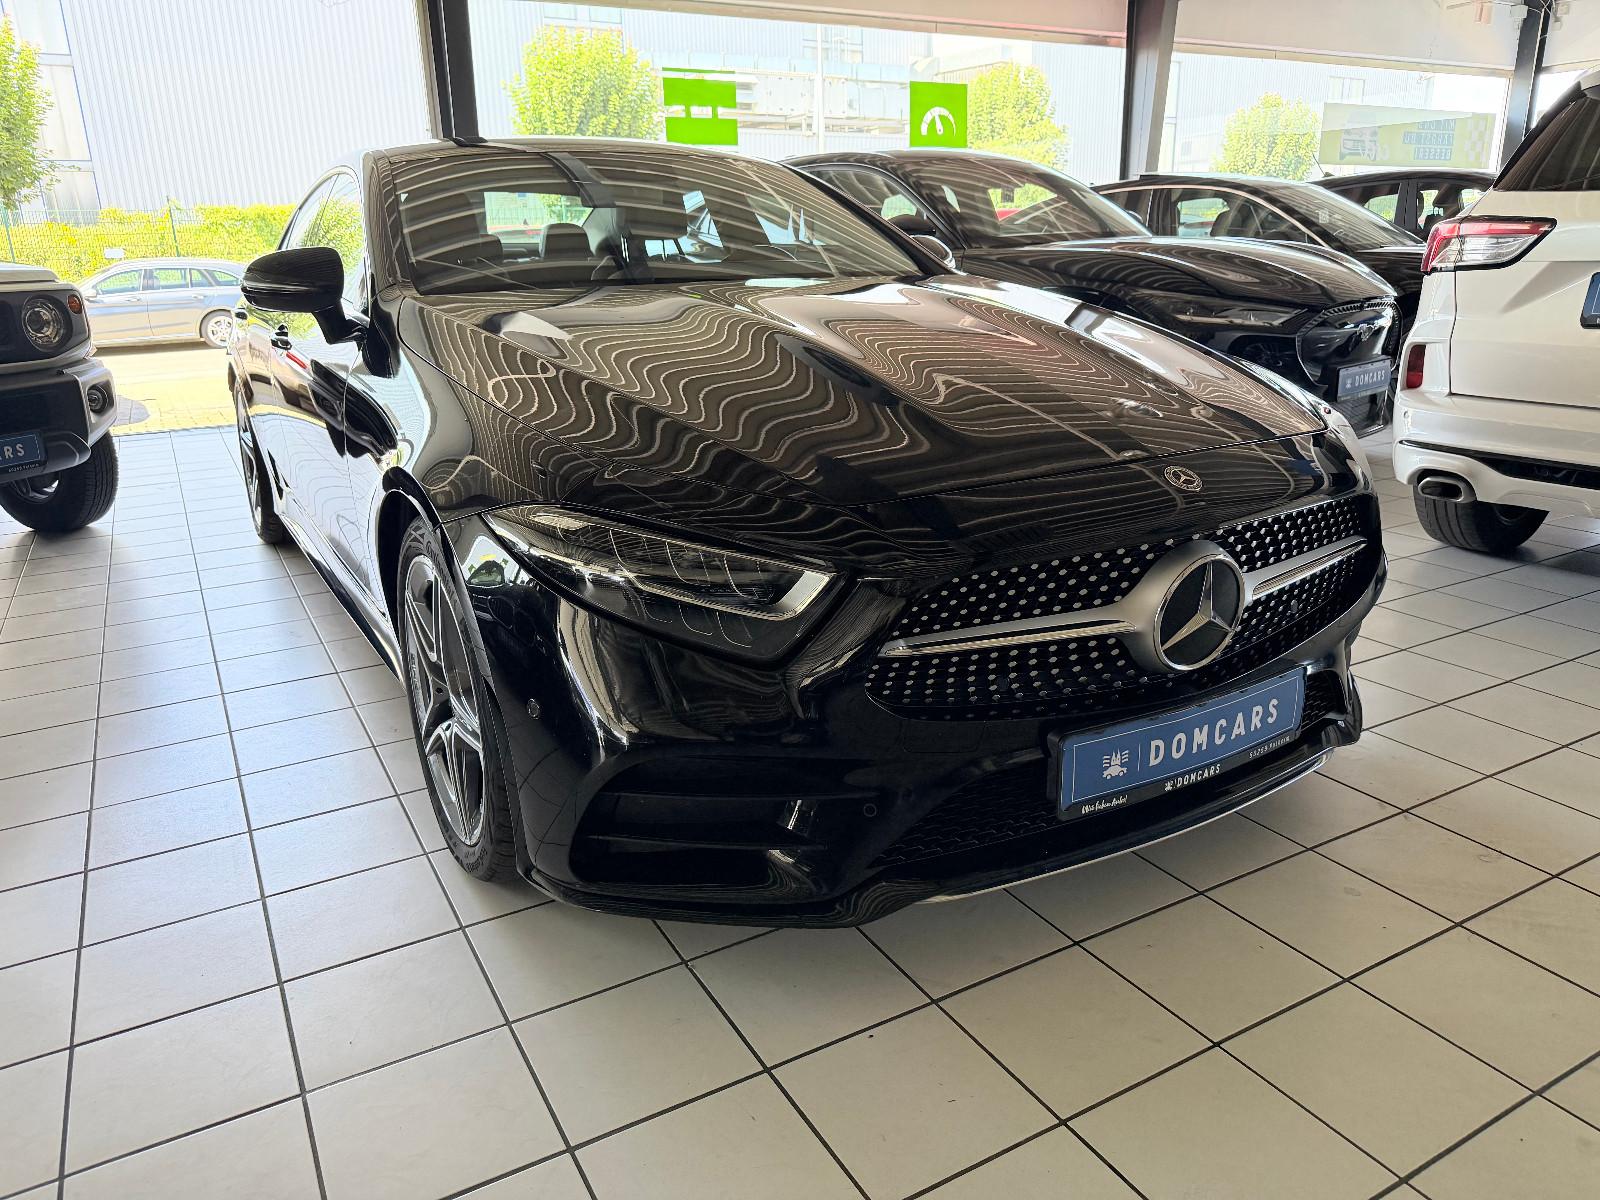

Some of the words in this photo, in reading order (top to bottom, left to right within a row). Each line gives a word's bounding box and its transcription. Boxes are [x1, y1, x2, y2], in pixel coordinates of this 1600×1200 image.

[1355, 370, 1385, 387] DOMCARS
[0, 443, 25, 460] RS
[1149, 698, 1279, 767] DOMCARS
[1176, 763, 1221, 788] DOMCARS
